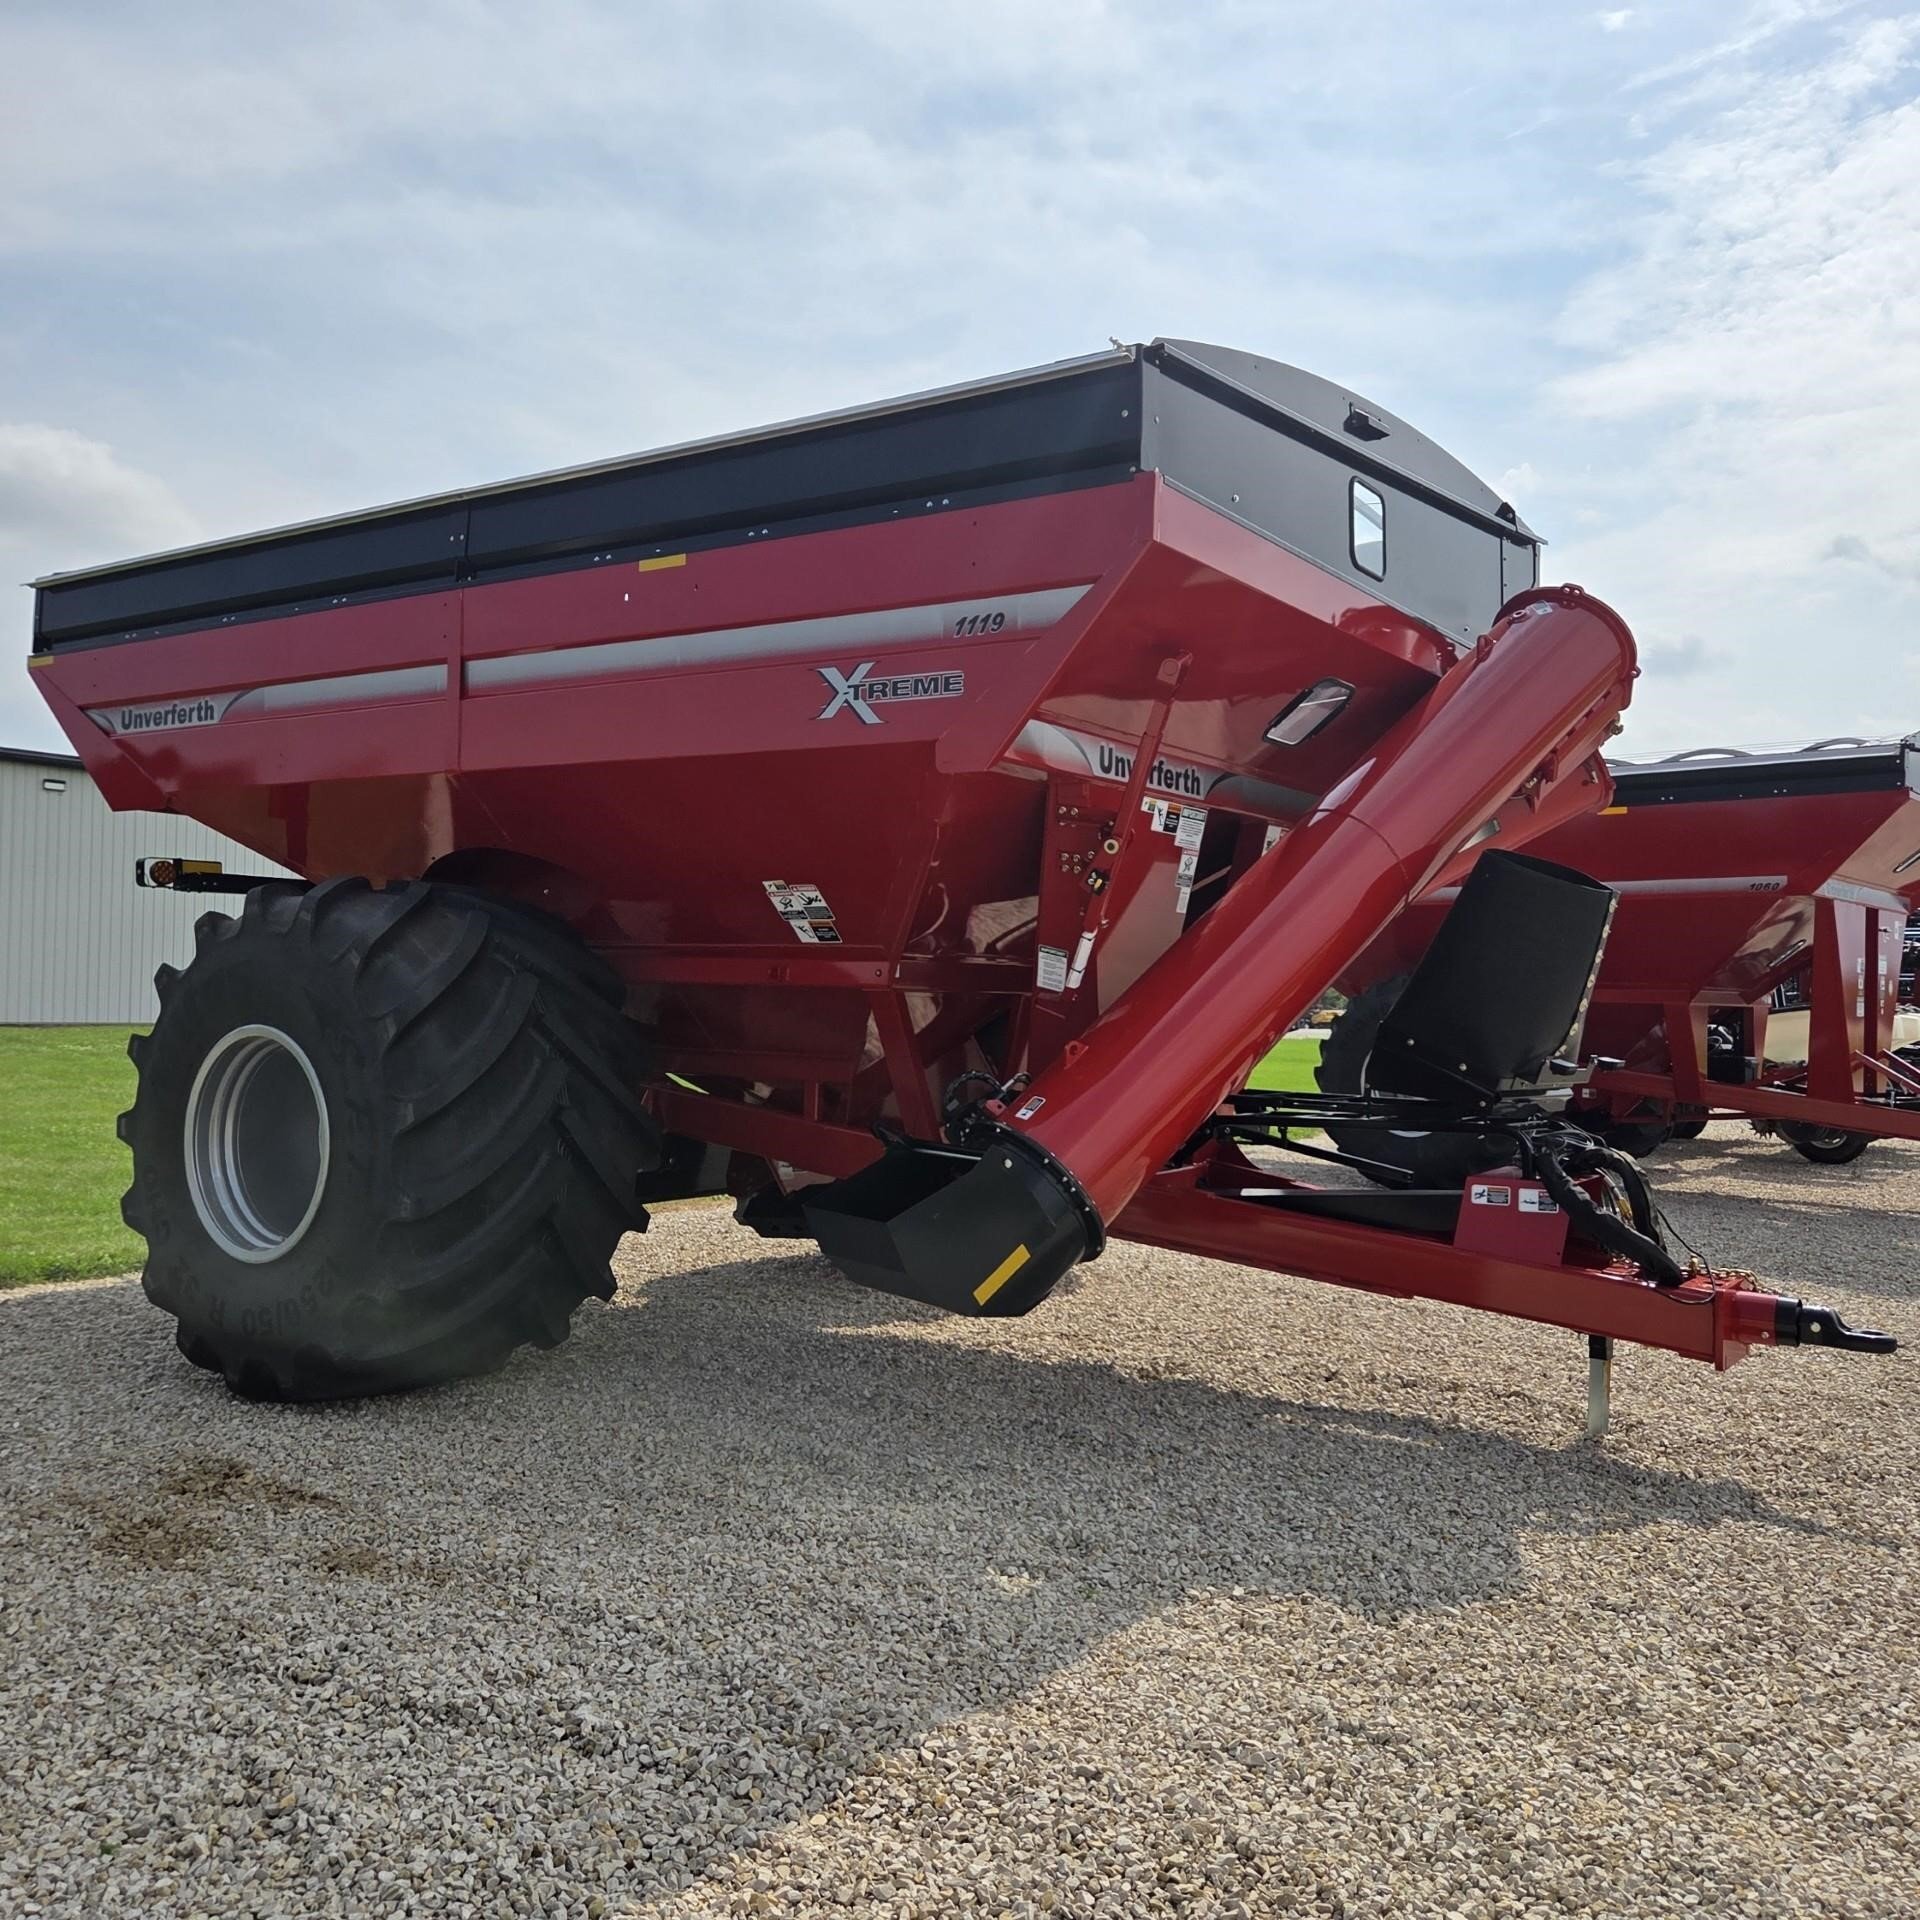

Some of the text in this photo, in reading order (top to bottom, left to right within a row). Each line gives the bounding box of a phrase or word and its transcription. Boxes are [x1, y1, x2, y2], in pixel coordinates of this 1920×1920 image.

[954, 612, 1006, 637] 1119
[811, 661, 964, 725] XTREME
[121, 700, 215, 730] Unverferth
[1100, 745, 1201, 796] Unrferth
